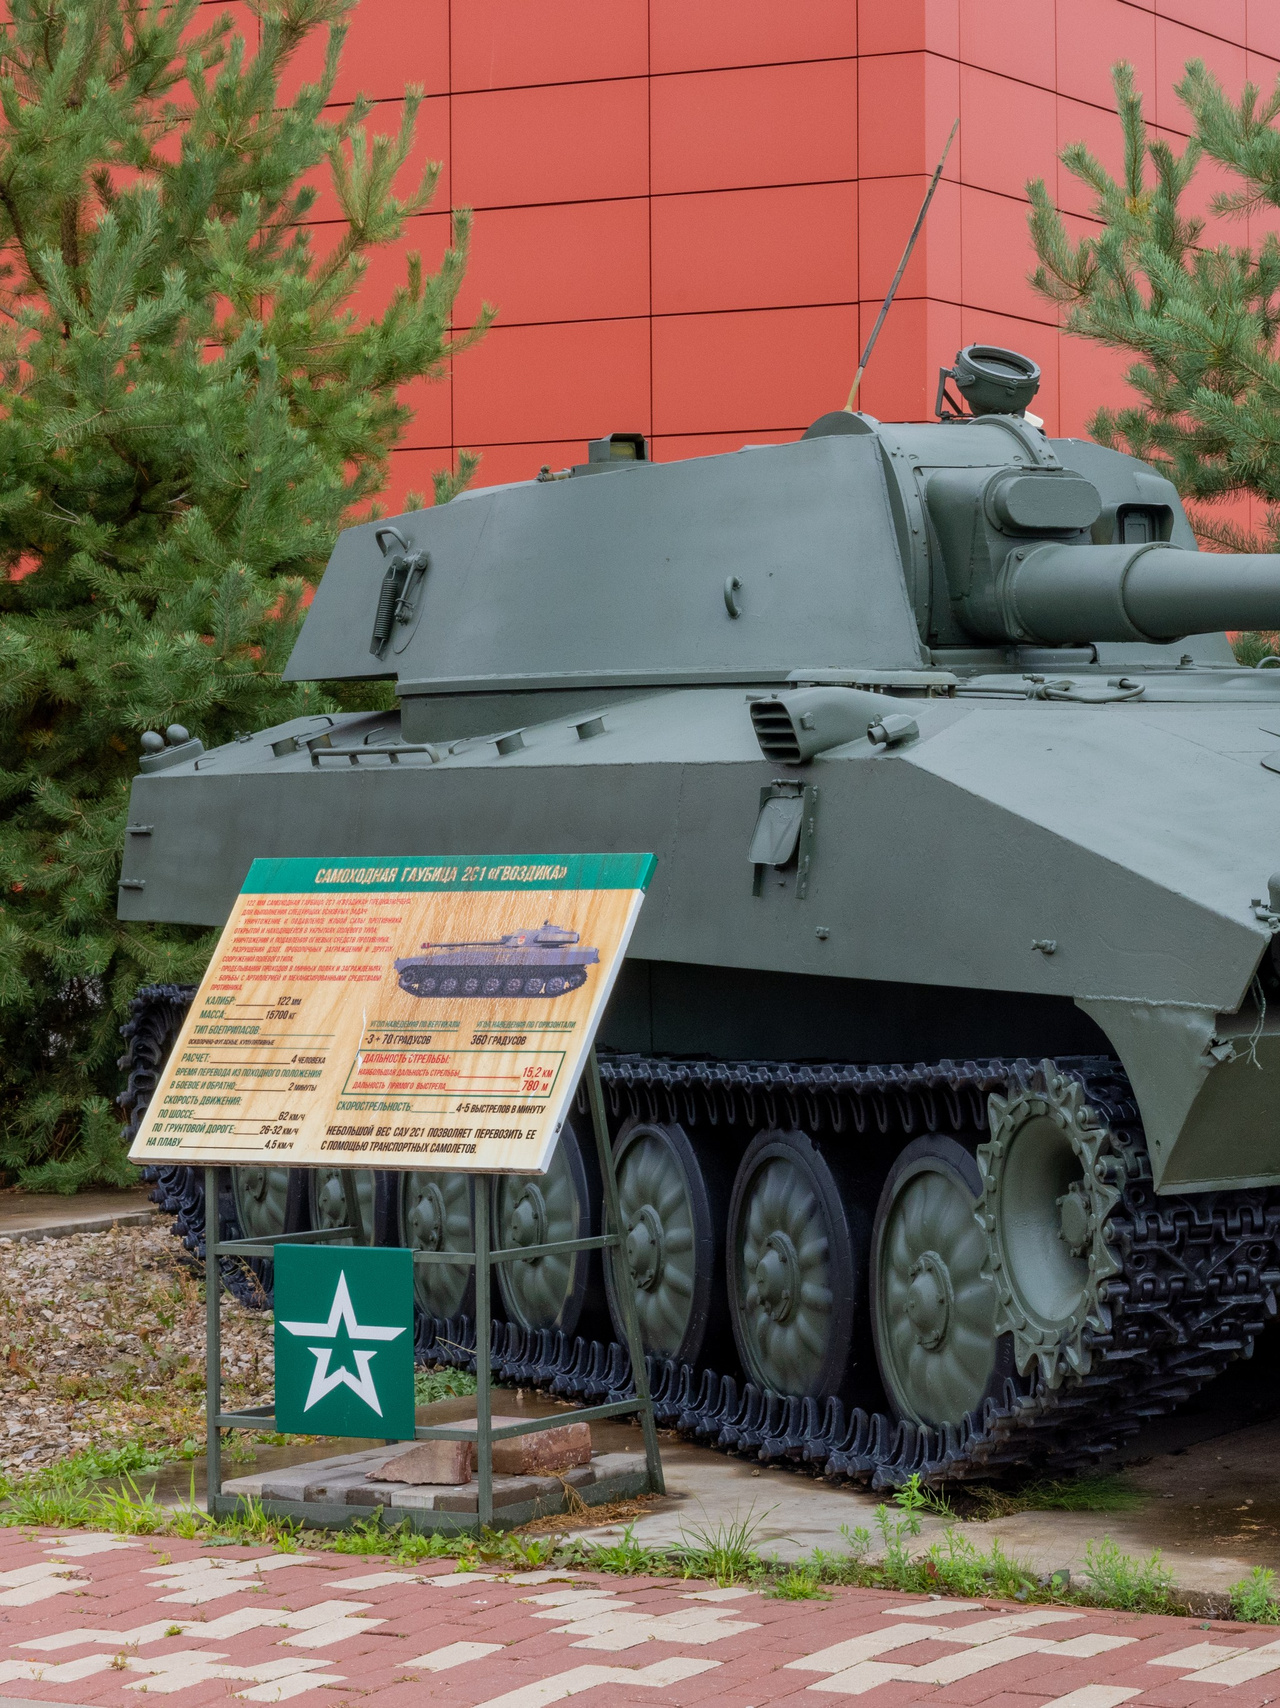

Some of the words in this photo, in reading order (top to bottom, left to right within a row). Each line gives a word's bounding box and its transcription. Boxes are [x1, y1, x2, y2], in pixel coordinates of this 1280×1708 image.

[315, 867, 398, 884] САМОХОДНАЯ
[400, 866, 458, 883] ГАУБИЦА
[488, 865, 567, 882] «ГВОЗДИКА»
[205, 996, 236, 1005] КАЛИБР:
[277, 996, 291, 1006] 122
[199, 1010, 226, 1019] МАССА:
[265, 1010, 288, 1020] 15700
[194, 1025, 208, 1035] ТИП
[208, 1025, 261, 1035] БОЕПРИПАСОВ:
[535, 1021, 577, 1029] ГОРИЗОНТАЛИ
[382, 1034, 393, 1045] 70
[393, 1035, 432, 1045] ГРАДУСОВ
[470, 1035, 488, 1045] 360
[487, 1036, 527, 1046] ГРАДУСОВ
[181, 1053, 211, 1062] РАСЧЕТ:
[291, 1054, 298, 1064] 4
[298, 1056, 326, 1064] ЧЕЛОВЕКА
[362, 1053, 407, 1063] ДАЛЬНОСТЬ
[407, 1053, 450, 1063] СТРЕЛЬБЫ:
[175, 1067, 197, 1077] ВРЕМЯ
[198, 1068, 231, 1077] ПЕРЕВОДА
[231, 1068, 241, 1077] ИЗ
[241, 1068, 281, 1078] ПОХОДНОГО
[281, 1069, 323, 1078] ПОЛОЖЕНИЯ
[396, 1069, 429, 1077] ДАЛЬНОСТЬ
[429, 1069, 460, 1077] СТРЕЛЬБЫ
[522, 1066, 541, 1078] 15,2
[175, 1080, 200, 1089] БОЕВОЕ
[206, 1081, 237, 1090] ОБРАТНО:
[288, 1082, 294, 1091] 2
[294, 1083, 318, 1091] МИНУТЫ
[352, 1081, 385, 1089] ДАЛЬНОСТЬ
[415, 1082, 446, 1090] ВЫСТРЕЛА
[521, 1080, 540, 1091] 780
[163, 1095, 199, 1105] СКОРОСТЬ
[199, 1095, 242, 1106] ДВИЖЕНИЯ:
[336, 1101, 414, 1112] СКОРОСТРЕЛЬНОСТЬ:
[456, 1103, 471, 1113] 4-5
[470, 1104, 511, 1114] ВЫСТРЕЛОВ
[511, 1105, 517, 1114] В
[518, 1105, 546, 1114] МИНУТУ
[158, 1109, 169, 1118] ПО
[168, 1109, 195, 1119] ШОССЕ:
[278, 1111, 289, 1121] 62
[152, 1123, 163, 1132] ПО
[165, 1122, 206, 1133] ГРУНТОВОЙ
[205, 1124, 236, 1134] ДОРОГЕ:
[259, 1125, 282, 1135] 26-32
[326, 1124, 374, 1137] НЕБОЛЬШОЙ
[375, 1126, 391, 1137] ВЕС
[393, 1127, 409, 1137] САУ
[427, 1127, 473, 1138] ПОЗВОЛЯЕТ
[474, 1128, 523, 1140] ПЕРЕВОЗИТЬ
[525, 1129, 538, 1140] ЕЕ
[146, 1137, 156, 1146] НА
[157, 1137, 183, 1146] ПЛАВУ
[264, 1139, 277, 1149] 4,5
[320, 1141, 327, 1150] С
[327, 1141, 370, 1152] ПОМОЩЬЮ
[370, 1142, 430, 1153] ТРАНСПОРТНЫХ
[430, 1142, 477, 1154] САМОЛЕТОВ.
